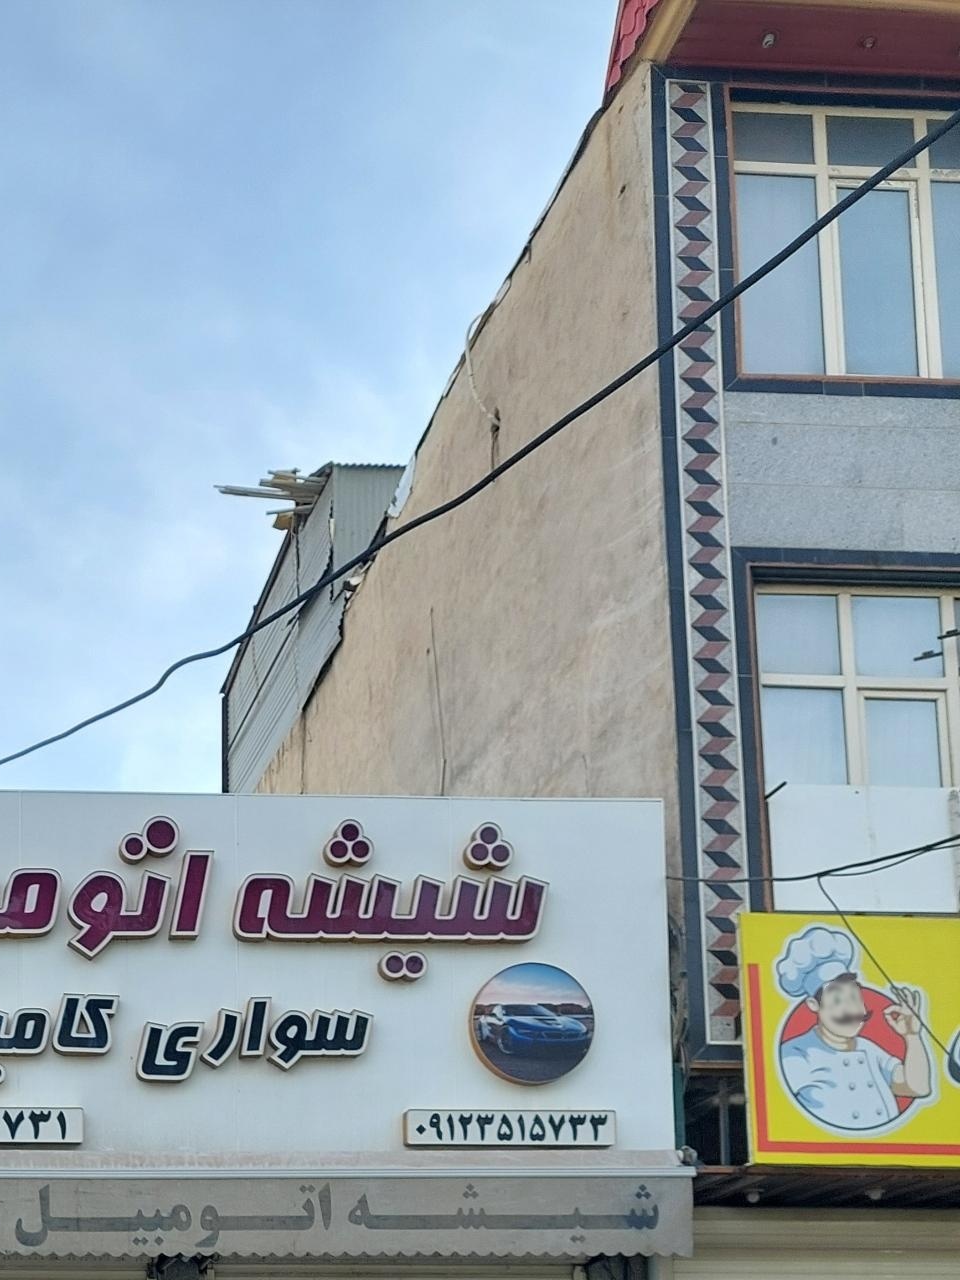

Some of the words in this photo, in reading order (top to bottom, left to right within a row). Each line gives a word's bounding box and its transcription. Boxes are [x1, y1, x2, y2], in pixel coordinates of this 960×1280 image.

[233, 819, 549, 982] شیشه
[137, 997, 374, 1083] سواری
[415, 1111, 609, 1142] ۰۹۱۲۳۵۱۵۷۳۳
[15, 1183, 332, 1248] اتومبیل
[349, 1183, 659, 1244] شیشه
